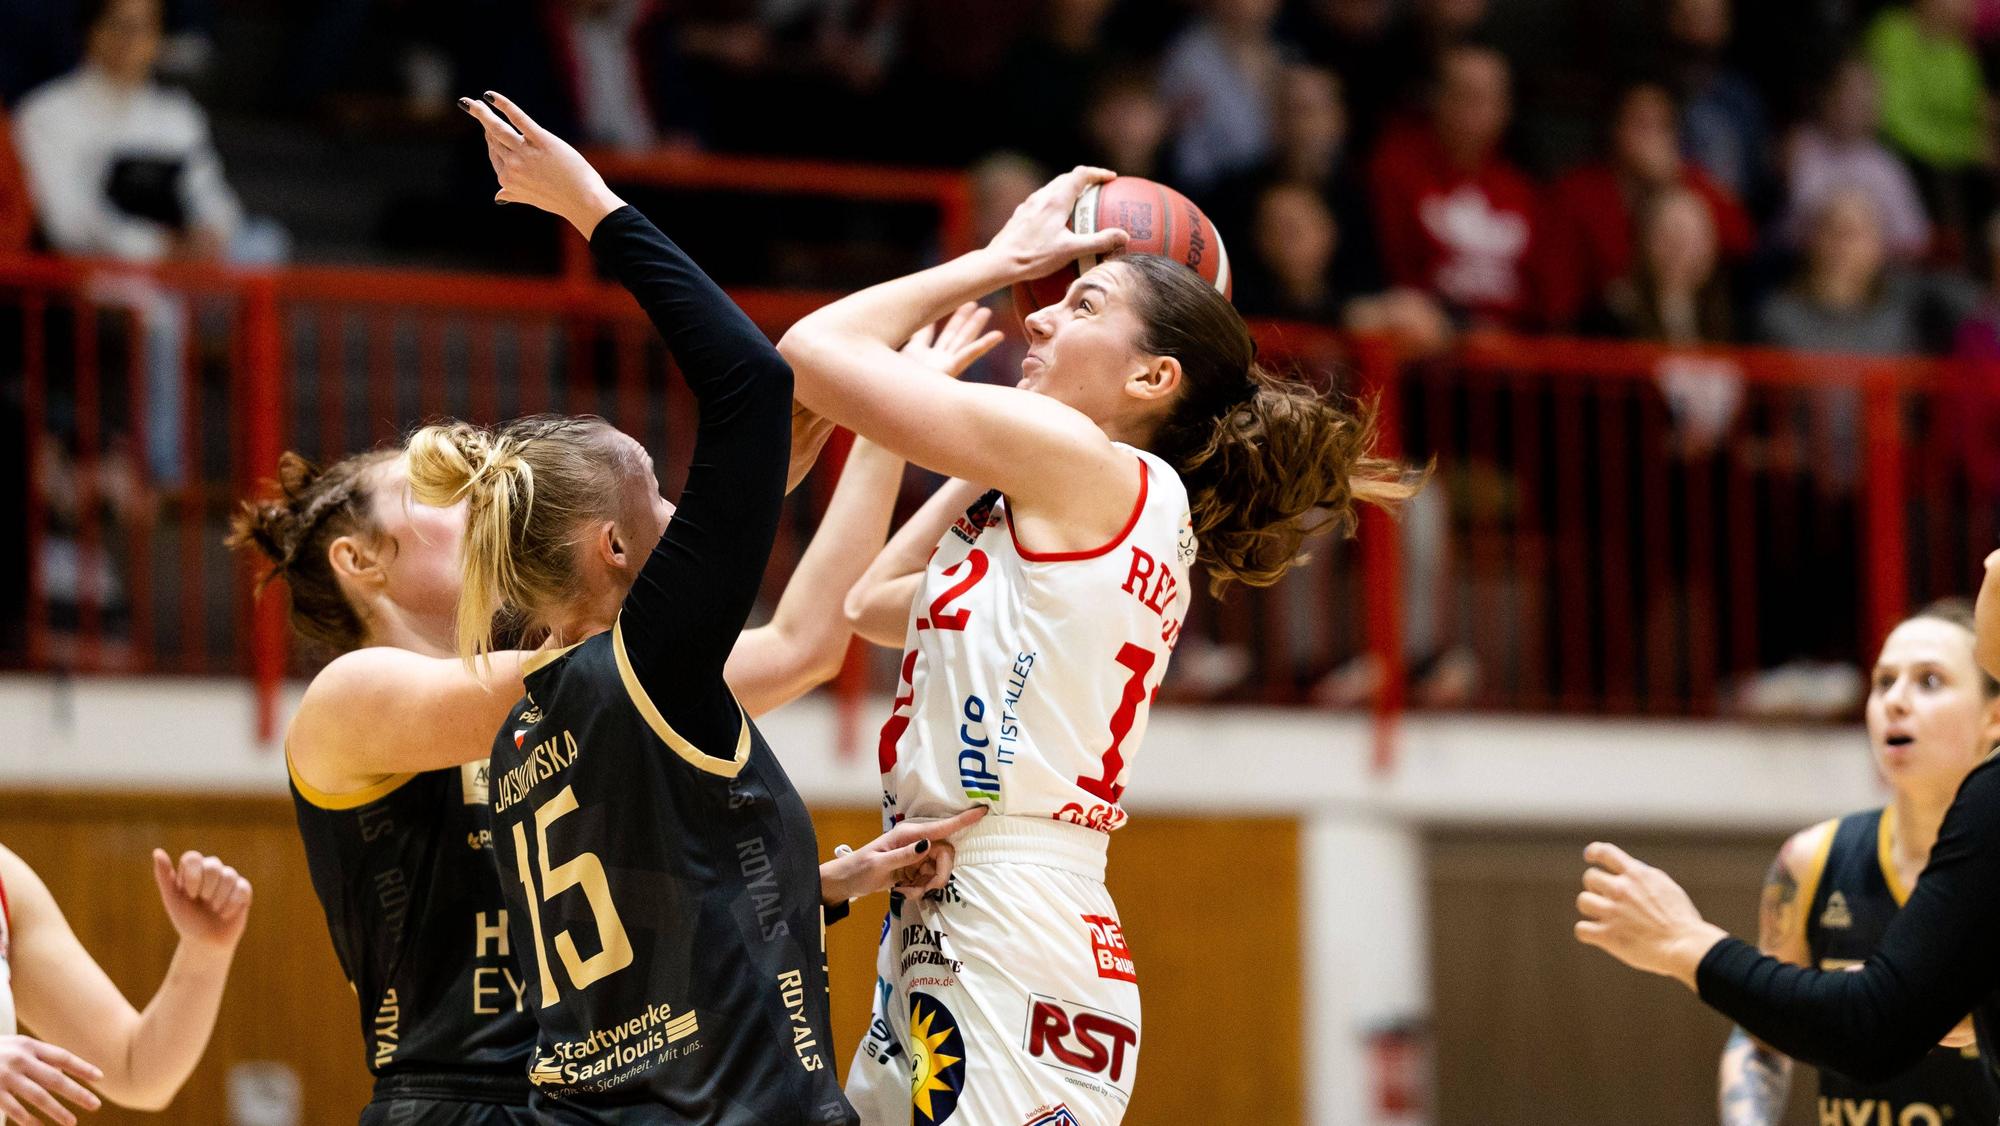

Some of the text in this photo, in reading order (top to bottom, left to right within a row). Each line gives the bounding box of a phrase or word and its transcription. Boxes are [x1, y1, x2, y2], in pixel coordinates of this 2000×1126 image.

[996, 651, 1037, 765] IT IST ALLES.
[511, 783, 634, 1010] 15
[735, 836, 790, 943] ROYALS
[554, 1003, 672, 1064] Stadtwerke
[564, 1029, 665, 1085] Saarlouis
[657, 1049, 679, 1066] Mit
[683, 1040, 704, 1056] uns.
[777, 969, 824, 1073] ROYALS
[1029, 1000, 1137, 1082] RST
[1064, 1076, 1101, 1093] connected
